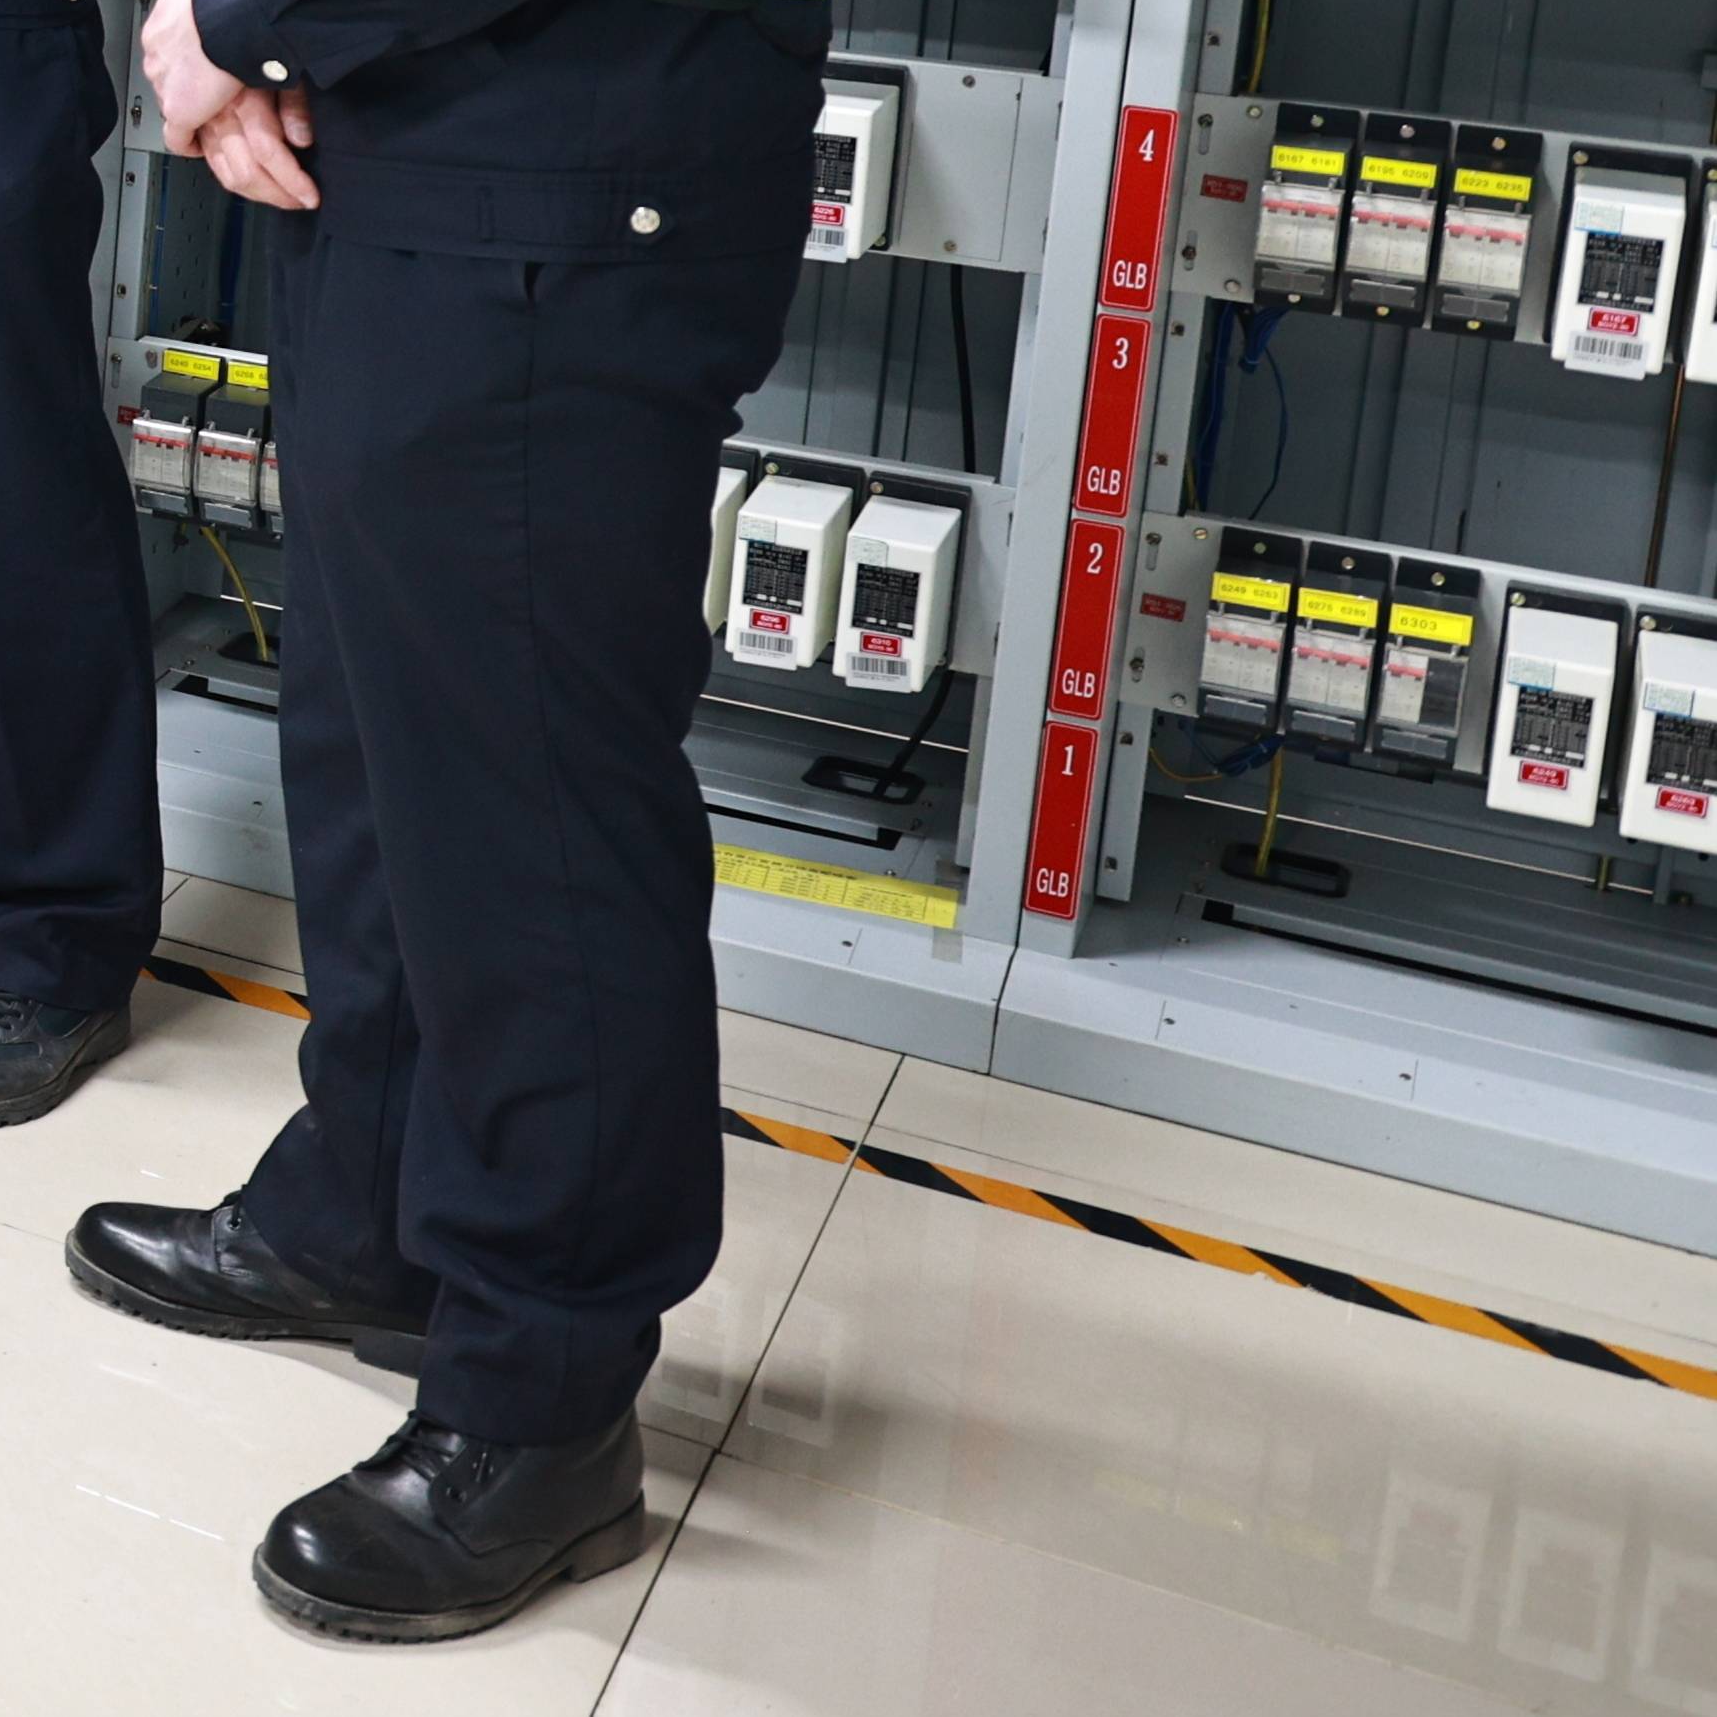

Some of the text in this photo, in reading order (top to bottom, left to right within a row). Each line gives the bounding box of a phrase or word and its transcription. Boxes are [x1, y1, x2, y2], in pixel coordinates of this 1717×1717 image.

[1138, 129, 1155, 162] 4
[1112, 259, 1148, 290] GLB
[1112, 337, 1129, 369] 3
[1087, 464, 1121, 496] GLB
[1087, 542, 1104, 574] 2
[1399, 616, 1439, 632] 6303
[1062, 667, 1095, 699] GLB
[1061, 744, 1075, 775] 1
[1036, 867, 1069, 898] GLB
